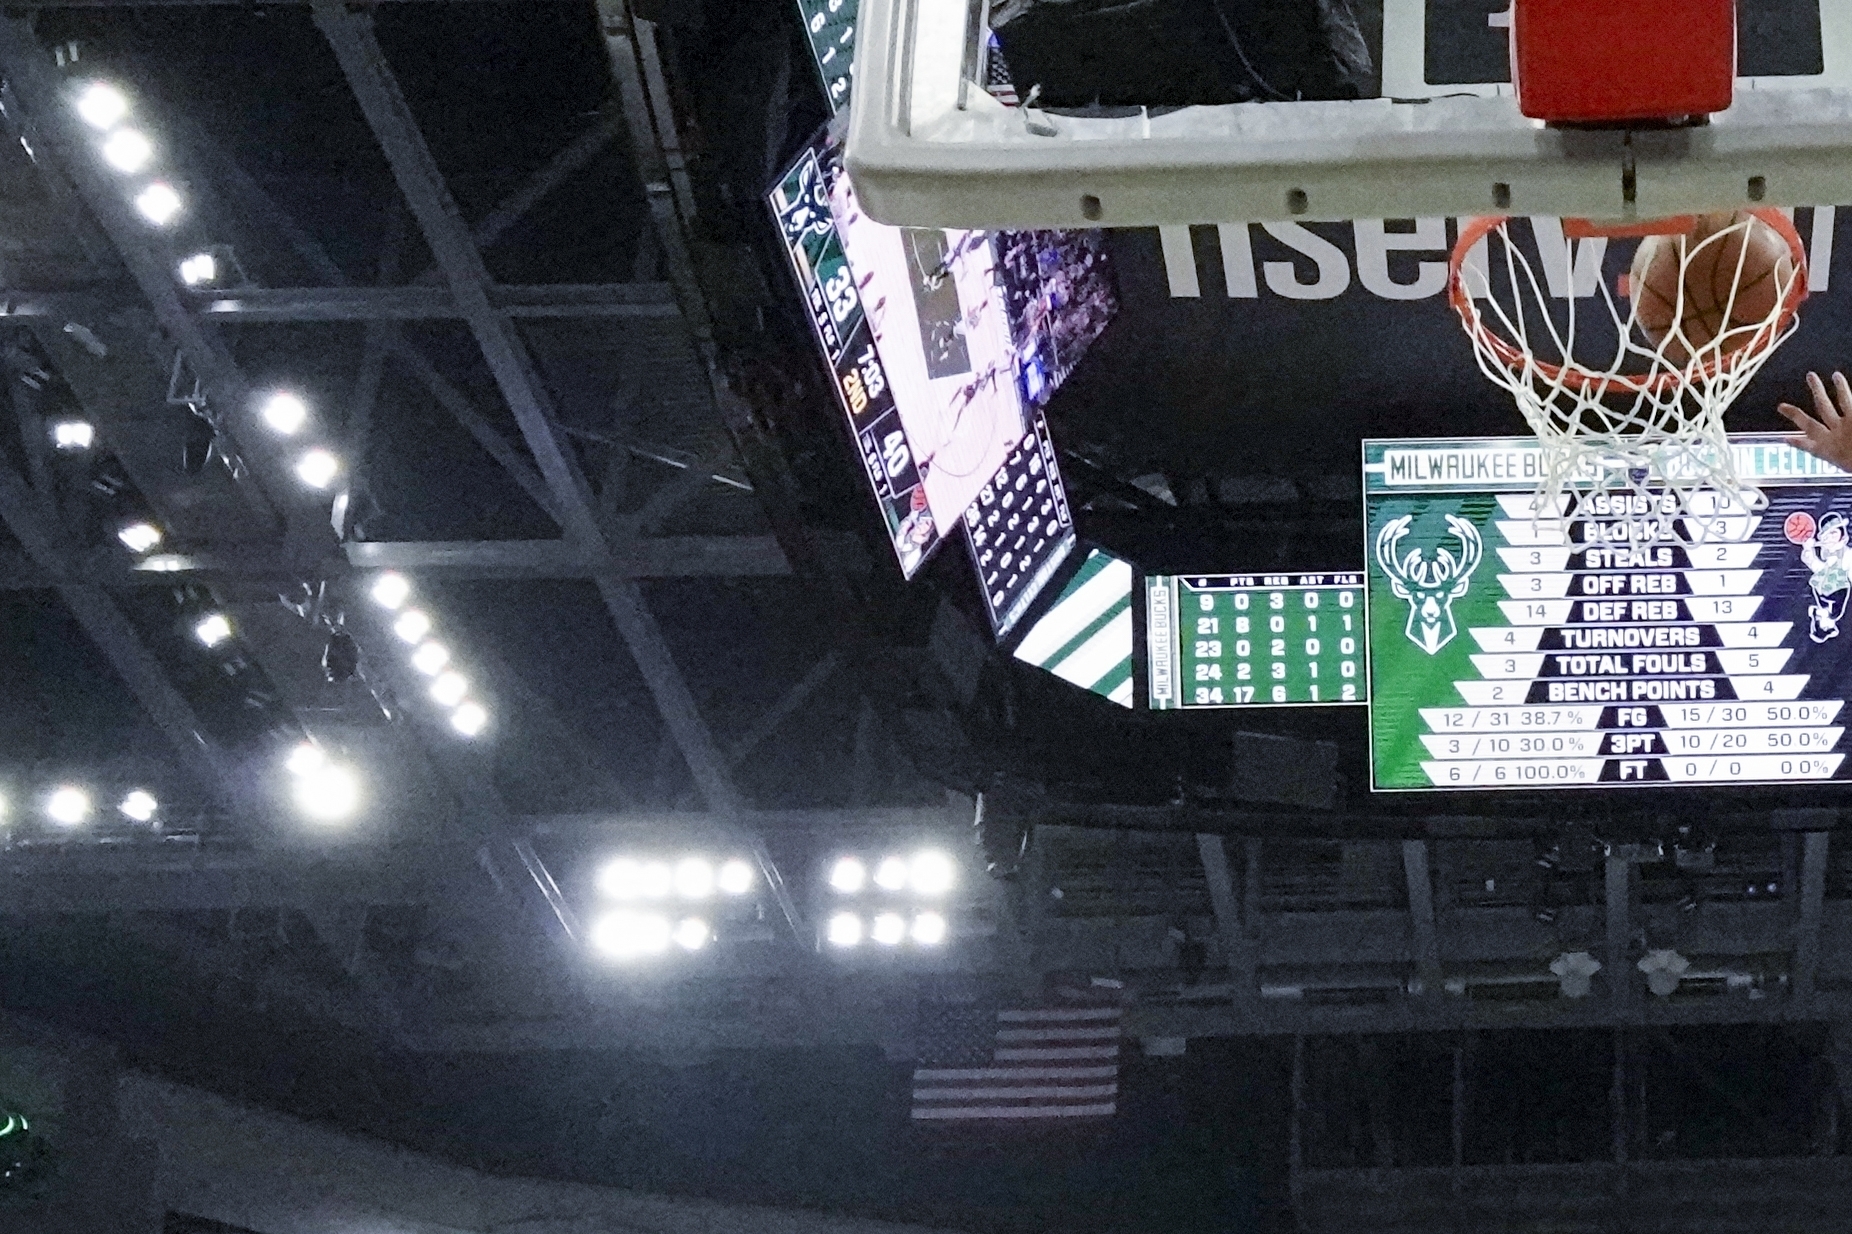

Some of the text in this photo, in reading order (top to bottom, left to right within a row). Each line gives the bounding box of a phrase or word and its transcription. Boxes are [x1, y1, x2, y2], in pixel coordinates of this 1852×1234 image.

[826, 266, 857, 322] 33
[858, 344, 885, 399] 7:03
[843, 368, 867, 415] 2ND
[884, 430, 909, 477] 40
[1391, 452, 1517, 478] MILWAUKEE
[1717, 522, 1726, 534] 3
[1530, 548, 1727, 567] 3 STEALS 2
[1530, 575, 1726, 594] 3 OFF REB 1
[1200, 592, 1353, 610] 9 0 3 0 0
[1526, 600, 1732, 620] 14 DEF REB 13
[1198, 615, 1351, 634] 21 8 0 1 1
[1504, 626, 1759, 647] 4 TURNOVERS 4
[1196, 638, 1354, 657] 23 0 2 0 0
[1196, 661, 1355, 680] 24 2 3 1 0
[1505, 654, 1759, 675] 3 TOTAL FOULS 5
[1196, 684, 1355, 704] 34 17 6 1 2
[1492, 680, 1774, 701] 2 BENCH POINTS 4
[1444, 706, 1828, 727] 12 31 FG 15 30 50.0%
[1448, 740, 1460, 753] 3
[1489, 739, 1509, 753] 10
[1611, 734, 1655, 753] 3PT
[1680, 735, 1700, 748] 10
[1723, 734, 1746, 748] 20
[1768, 732, 1828, 748] 50.0%
[1449, 767, 1460, 781] 6
[1495, 767, 1506, 780] 6
[1516, 764, 1585, 780] 100.0%
[1619, 761, 1648, 779] FT
[1686, 762, 1697, 776] 0
[1730, 762, 1741, 775] 0
